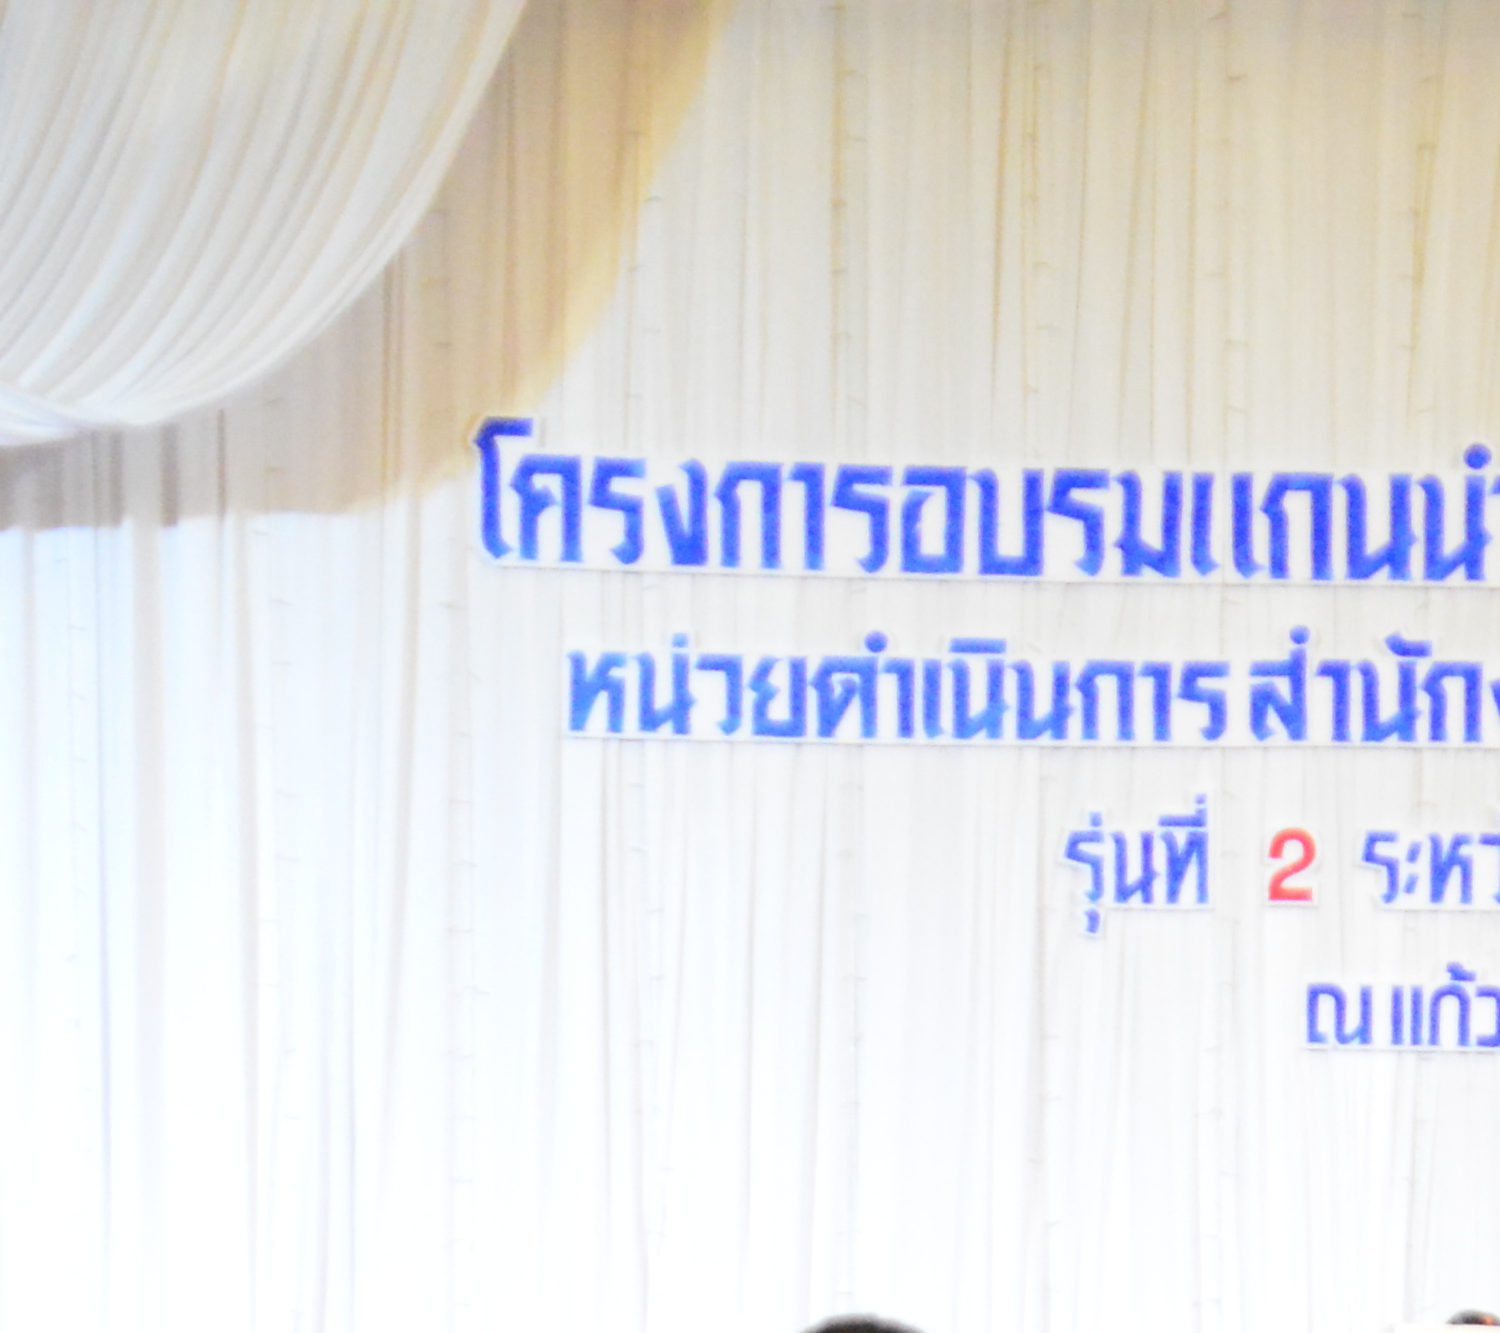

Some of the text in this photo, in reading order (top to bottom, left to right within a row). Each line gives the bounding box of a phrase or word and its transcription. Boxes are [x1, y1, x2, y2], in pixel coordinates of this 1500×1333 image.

[567, 630, 1232, 744] หน่วยดำเนินการ
[1062, 797, 1210, 934] รุ่นที่
[1267, 828, 1318, 902] 2
